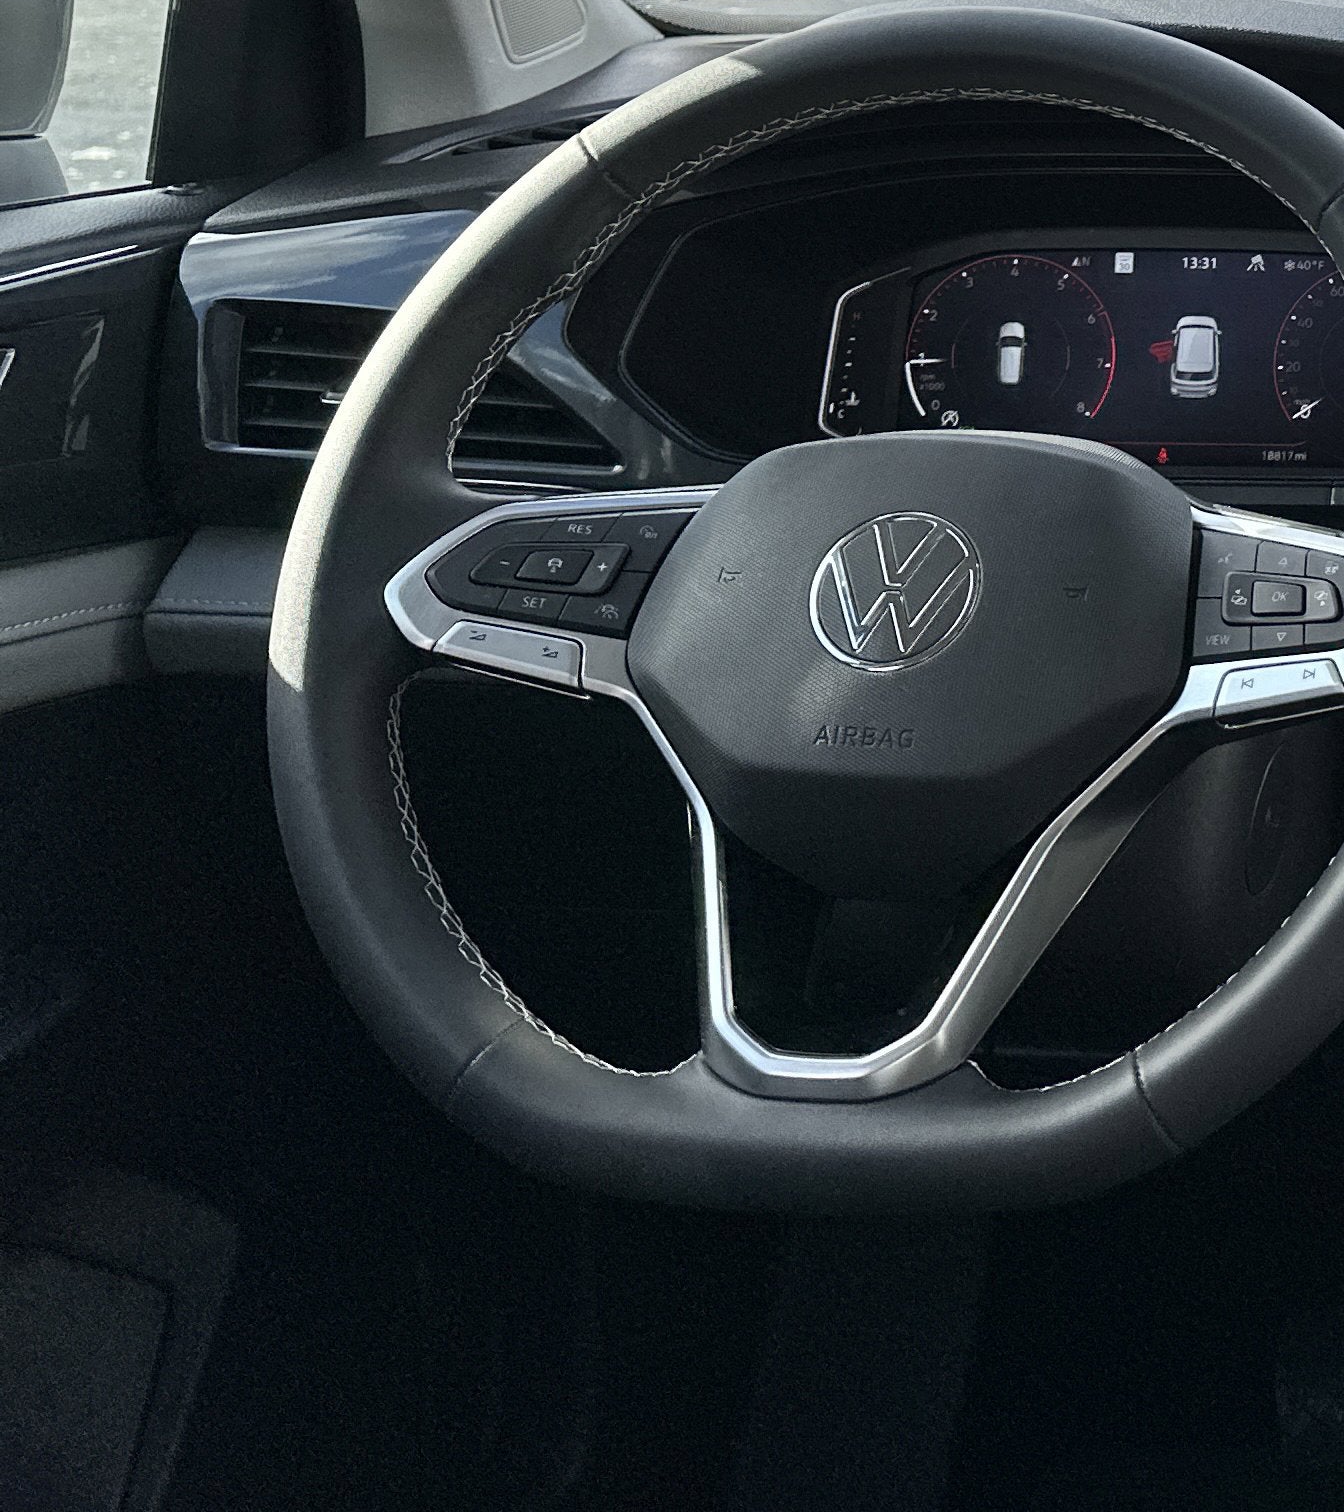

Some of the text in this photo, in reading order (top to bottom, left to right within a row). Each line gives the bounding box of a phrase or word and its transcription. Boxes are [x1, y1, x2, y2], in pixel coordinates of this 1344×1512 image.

[1182, 257, 1218, 270] 13:31
[1010, 266, 1019, 277] 4
[966, 276, 974, 288] 3
[1057, 279, 1065, 290] 5
[930, 311, 938, 322] 2
[1087, 314, 1096, 325] 6
[1076, 401, 1085, 412] 8
[567, 523, 593, 535] RES
[815, 514, 977, 663] VW
[521, 596, 547, 609] SET
[1271, 591, 1289, 602] OK
[1205, 634, 1231, 646] VIEW
[813, 725, 916, 750] AIRBAG
